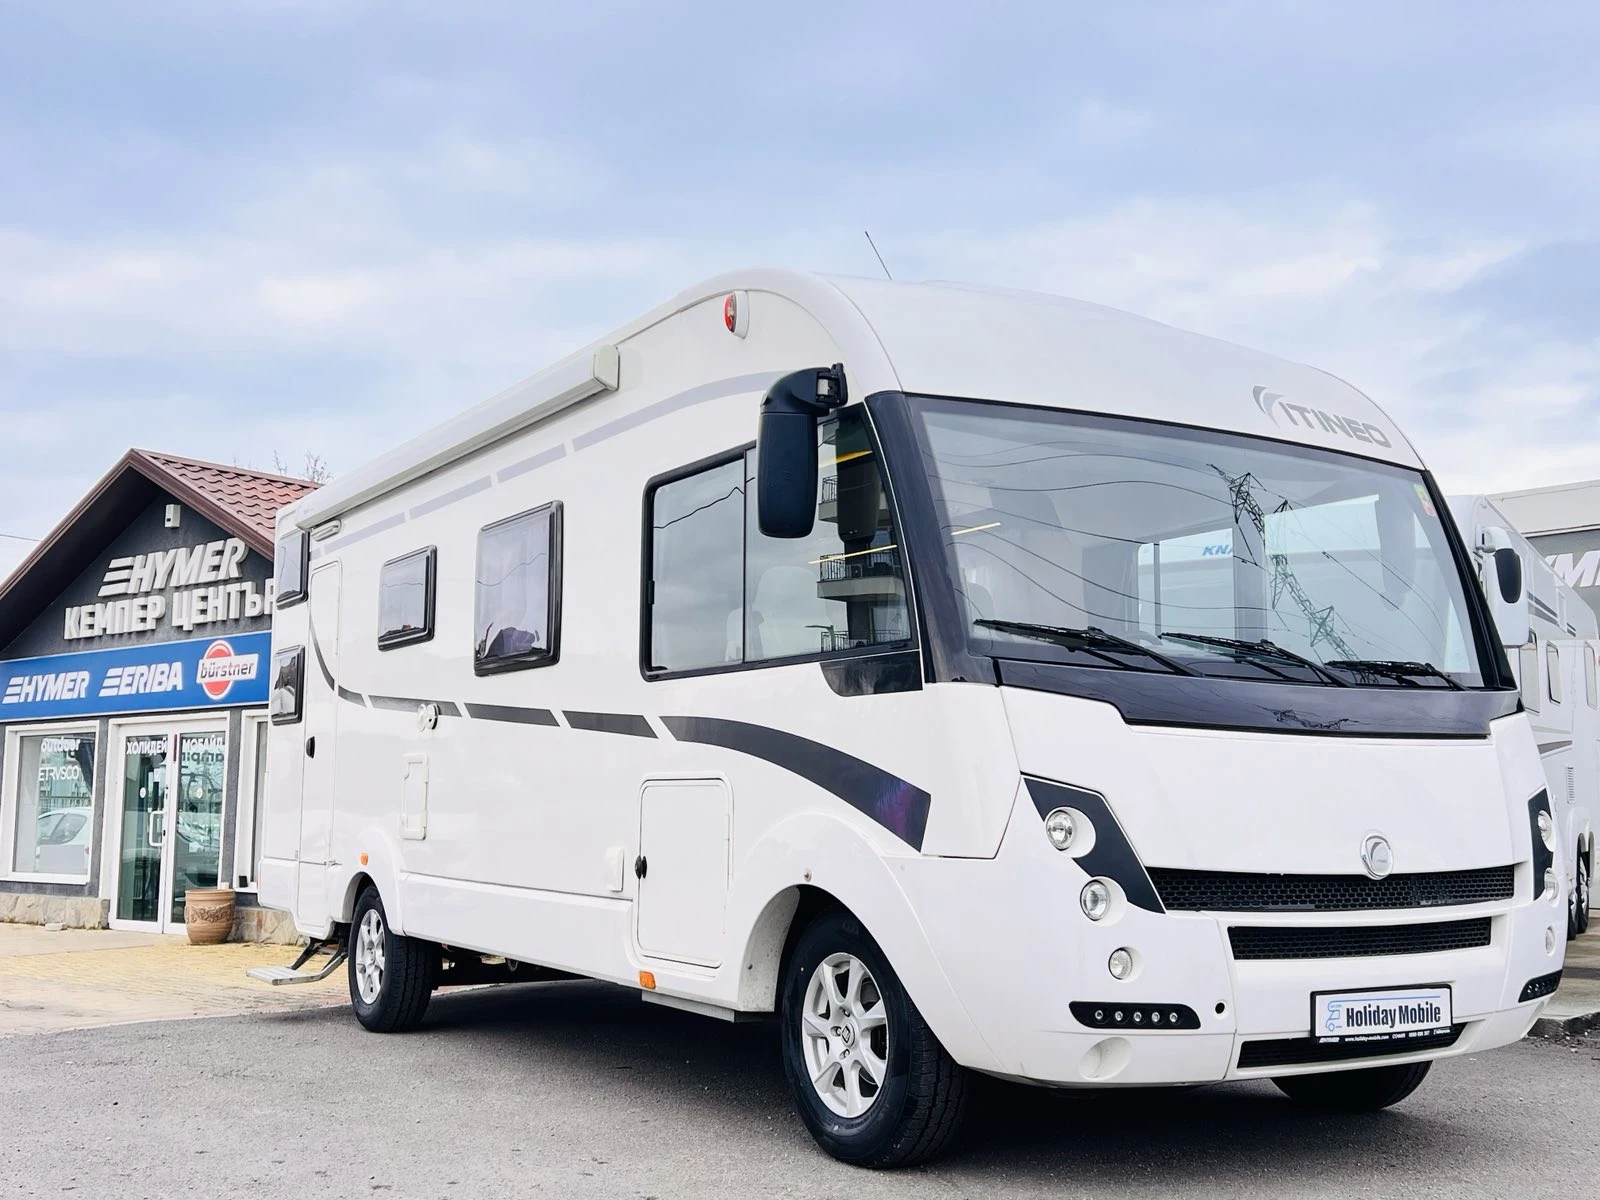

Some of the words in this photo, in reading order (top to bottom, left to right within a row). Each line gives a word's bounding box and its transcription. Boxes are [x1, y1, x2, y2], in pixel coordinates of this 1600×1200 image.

[1278, 400, 1392, 449] ITINEO
[127, 538, 249, 594] HYMER
[64, 596, 166, 640] КЕМПЕР
[19, 670, 90, 702] HYMER
[117, 662, 184, 696] ERIBA
[200, 662, 255, 679] bürstner
[1346, 1003, 1397, 1029] Holiday
[1399, 1001, 1441, 1025] Mobile
